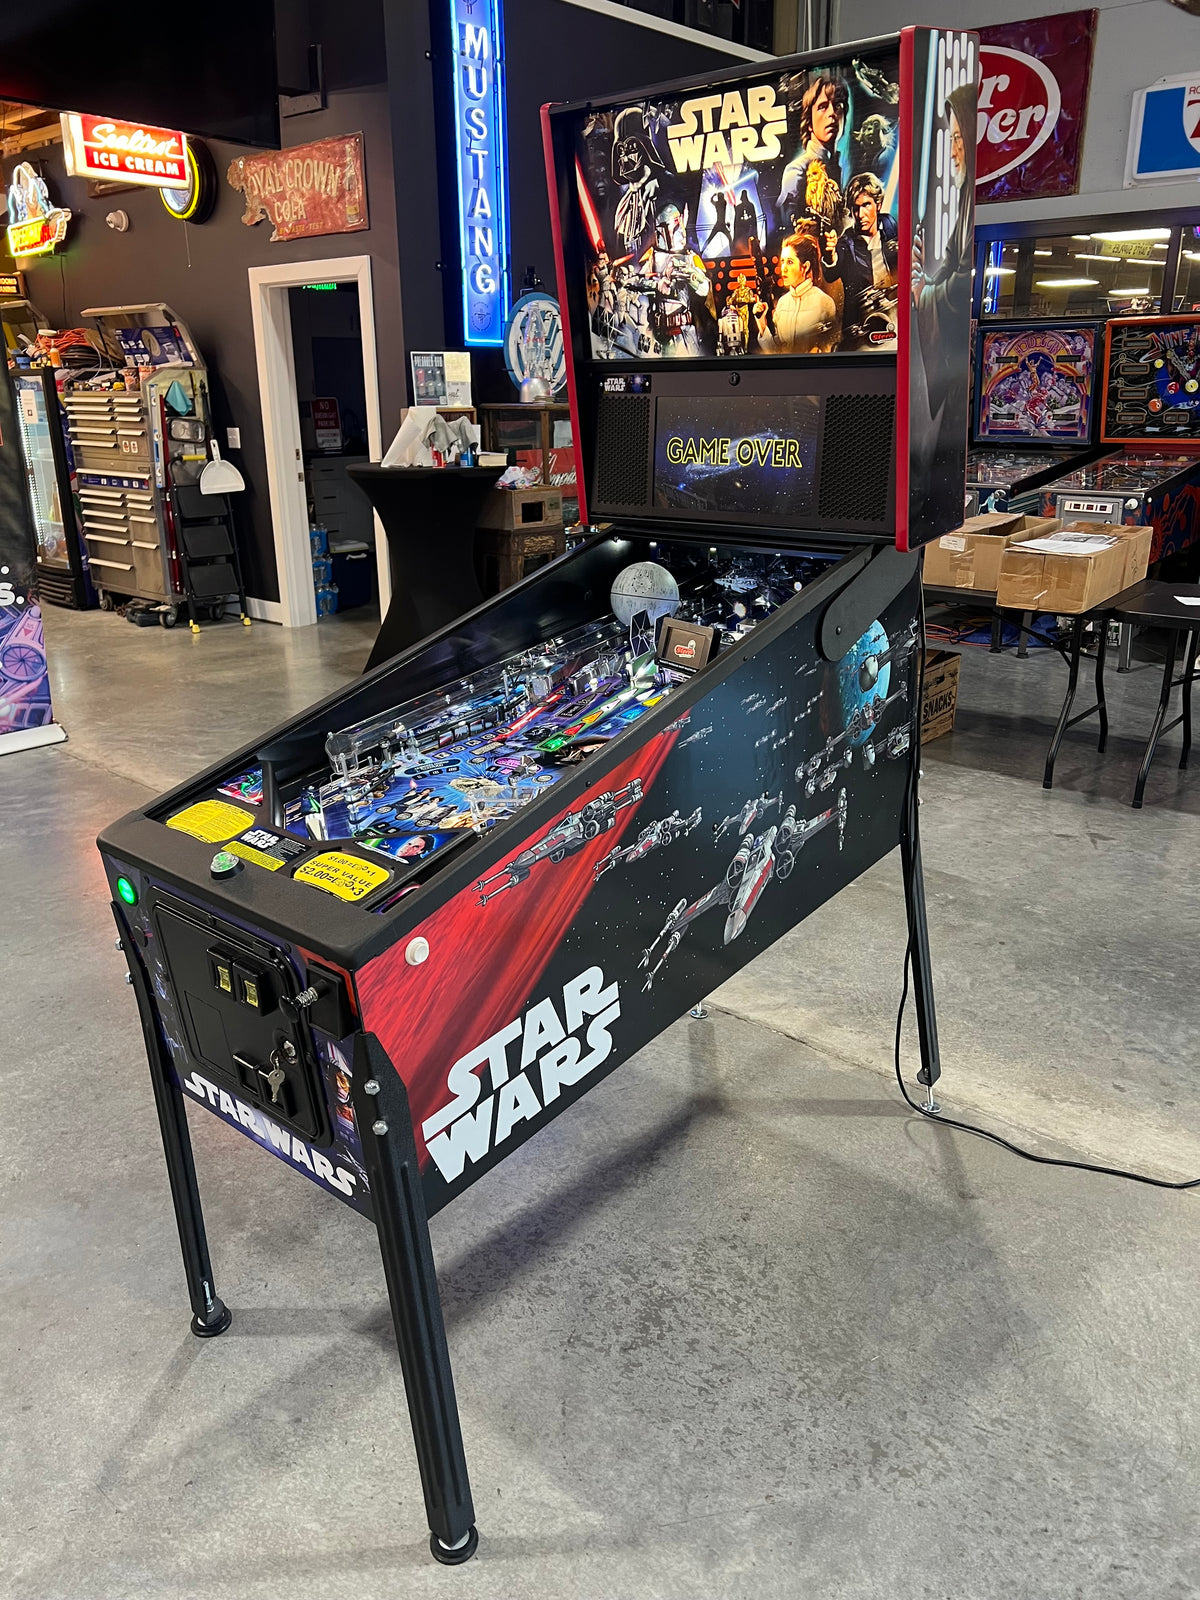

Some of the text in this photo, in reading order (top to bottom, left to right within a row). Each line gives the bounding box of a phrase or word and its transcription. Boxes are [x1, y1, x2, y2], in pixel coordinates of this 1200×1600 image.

[979, 60, 1010, 108] r
[667, 85, 787, 139] STAR
[86, 123, 183, 158] Sealtest
[668, 119, 788, 173] WARS
[93, 151, 180, 175] ICE CREAM
[458, 22, 496, 295] MUSTANG
[285, 158, 340, 197] CROWN
[274, 199, 307, 223] COLA
[1140, 329, 1190, 363] NINE
[604, 377, 626, 385] STAR
[604, 384, 626, 392] WARS
[319, 401, 330, 410] NO
[666, 437, 803, 468] GAME OVER
[923, 691, 952, 719] SNACKS
[240, 831, 277, 849] WARS
[249, 829, 280, 843] STAR
[310, 860, 373, 888] SUPER VALUE
[421, 965, 619, 1142] STAR
[425, 1000, 621, 1184] WARS
[184, 1071, 357, 1197] STAR WARS
